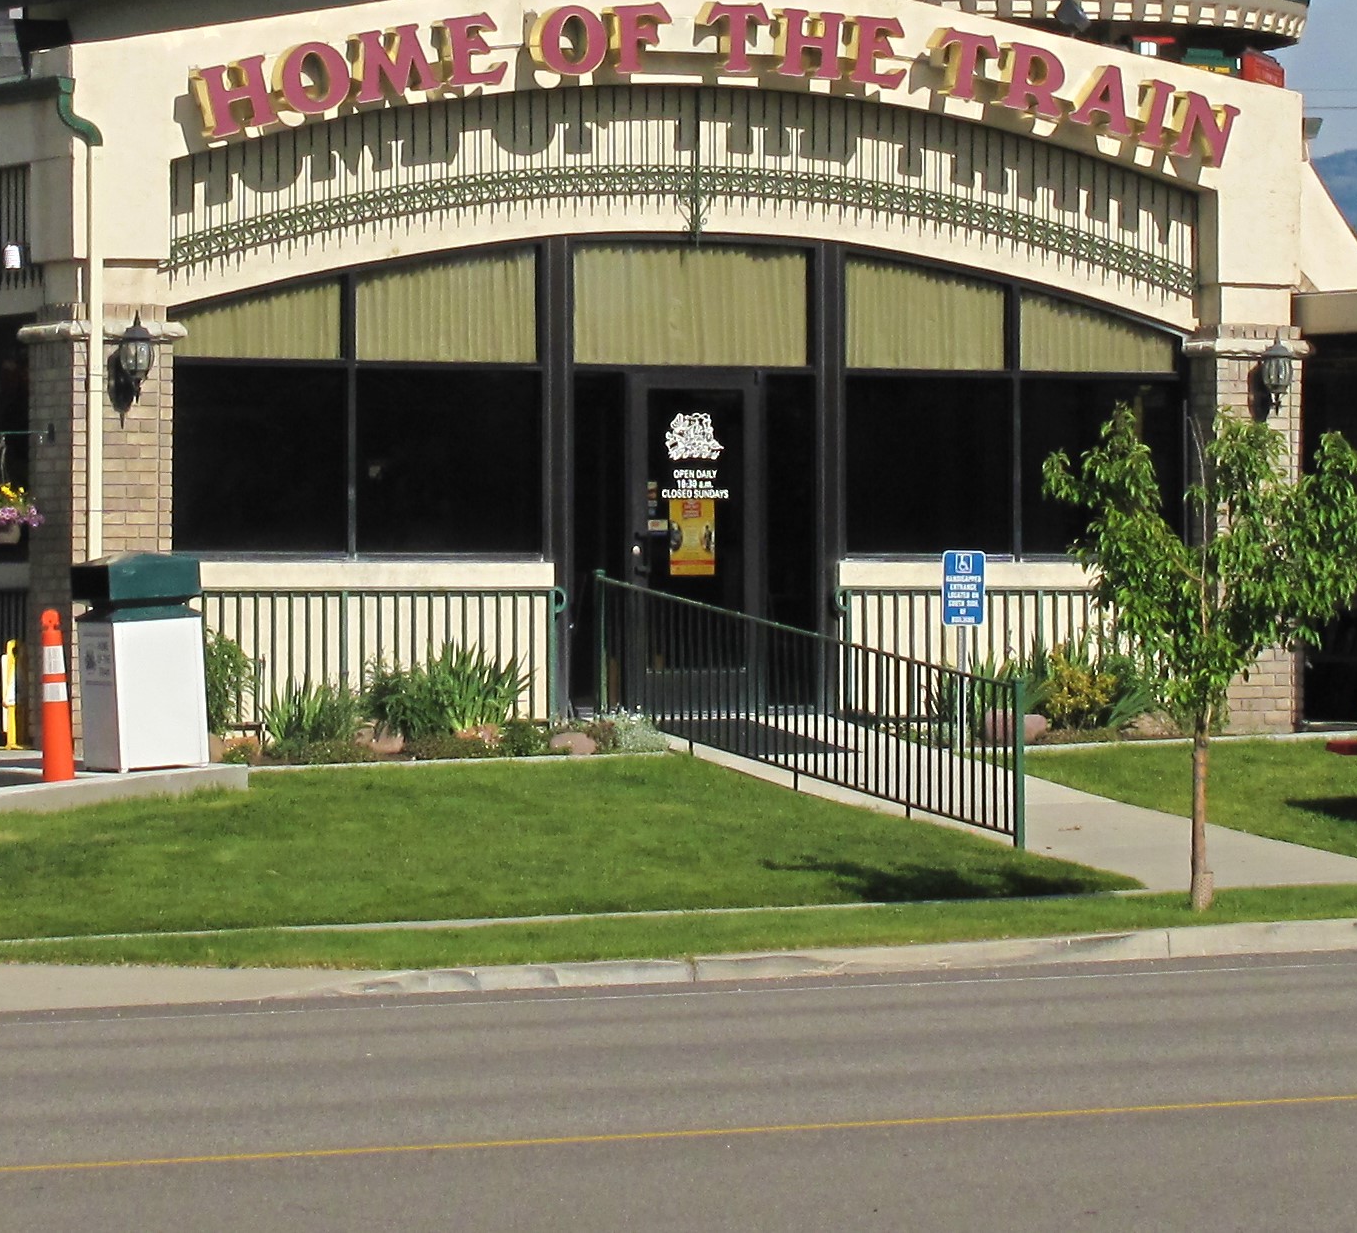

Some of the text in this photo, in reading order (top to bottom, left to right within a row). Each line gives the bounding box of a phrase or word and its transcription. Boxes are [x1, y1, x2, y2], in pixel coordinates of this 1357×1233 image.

[193, 1, 1241, 168] HOME OF THE TRAIN
[673, 469, 718, 479] OPEN DAILY
[661, 489, 729, 499] CLOSED SUNDAYS
